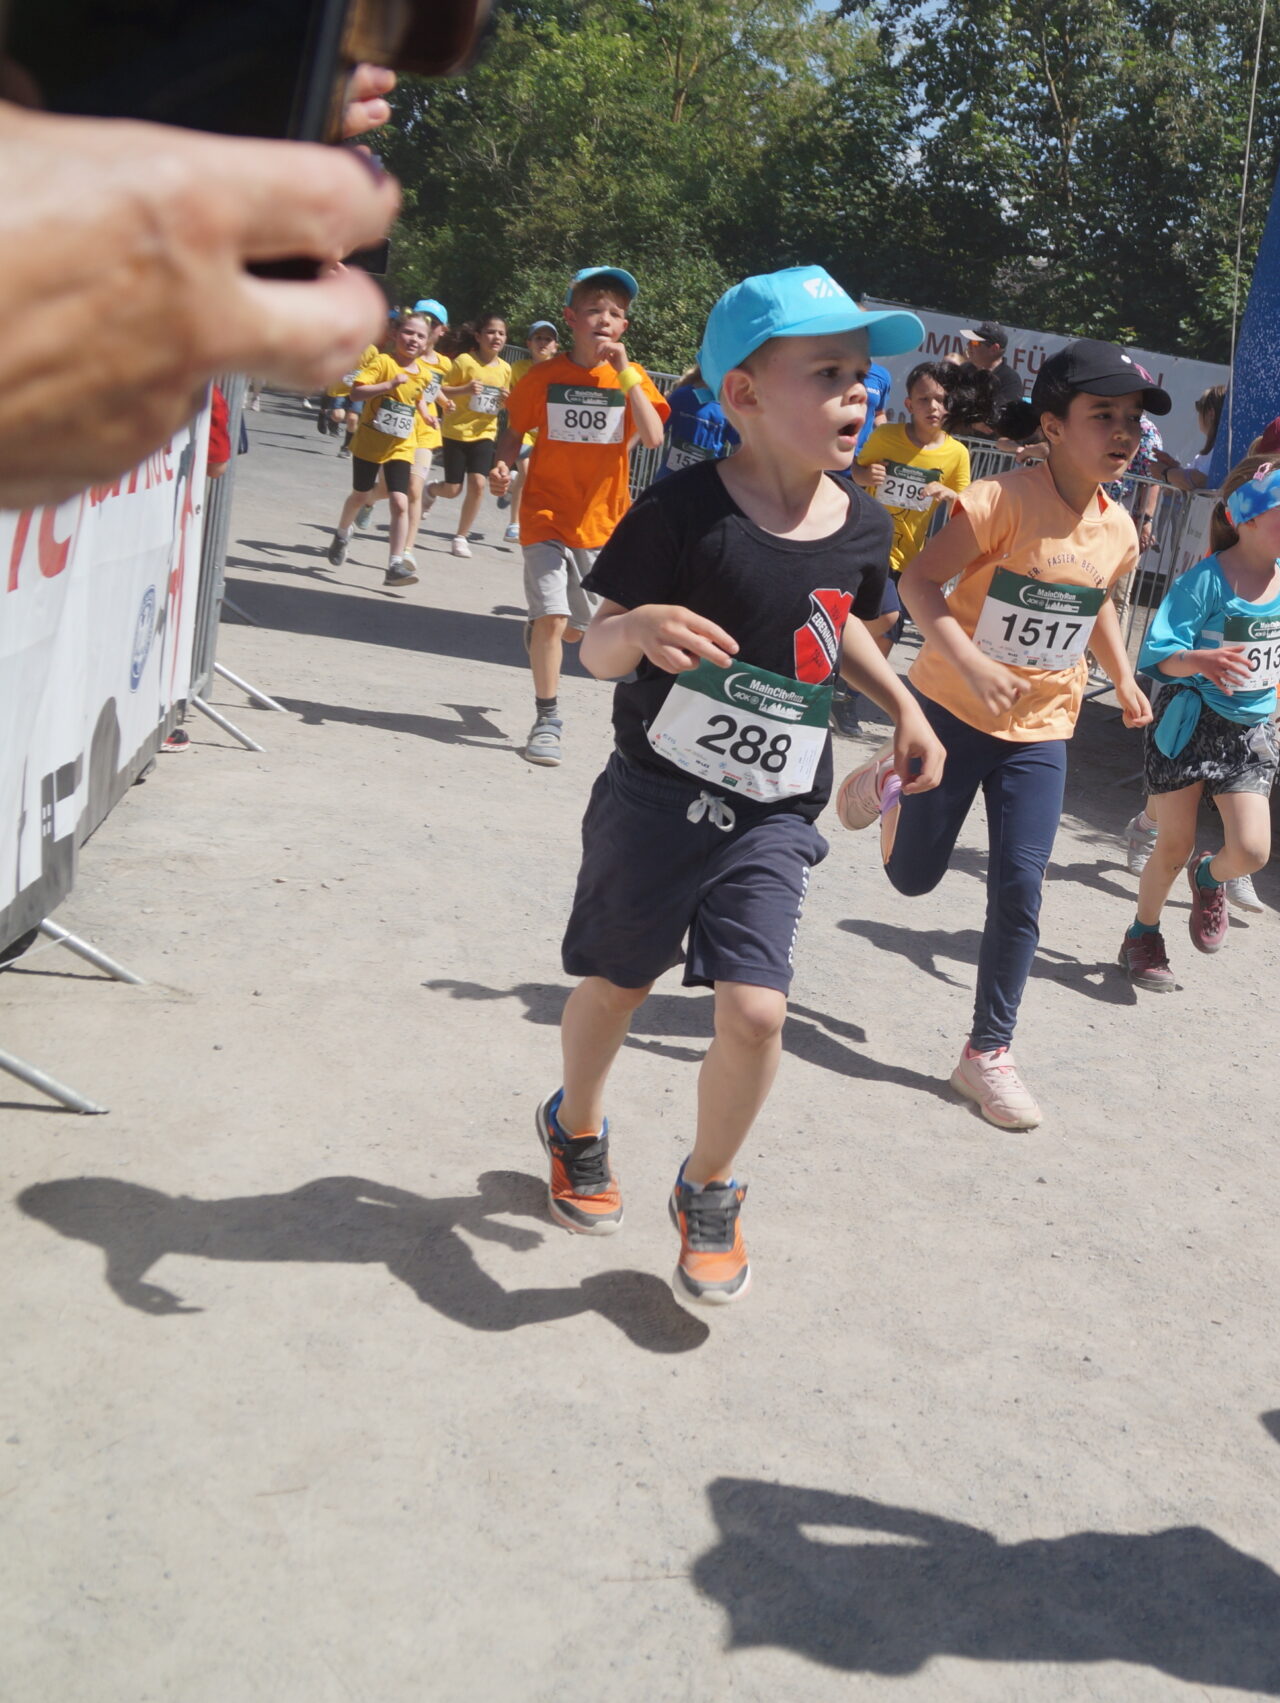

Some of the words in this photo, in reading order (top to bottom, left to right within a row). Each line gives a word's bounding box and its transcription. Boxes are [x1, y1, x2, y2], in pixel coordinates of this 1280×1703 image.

[1013, 345, 1047, 375] FÜ
[382, 413, 412, 431] 2158
[564, 409, 607, 430] 808
[1037, 588, 1077, 601] MainCityRun
[1001, 613, 1082, 650] 1517
[733, 692, 751, 702] AOK
[749, 679, 804, 703] MainCityRun
[696, 714, 792, 773] 288
